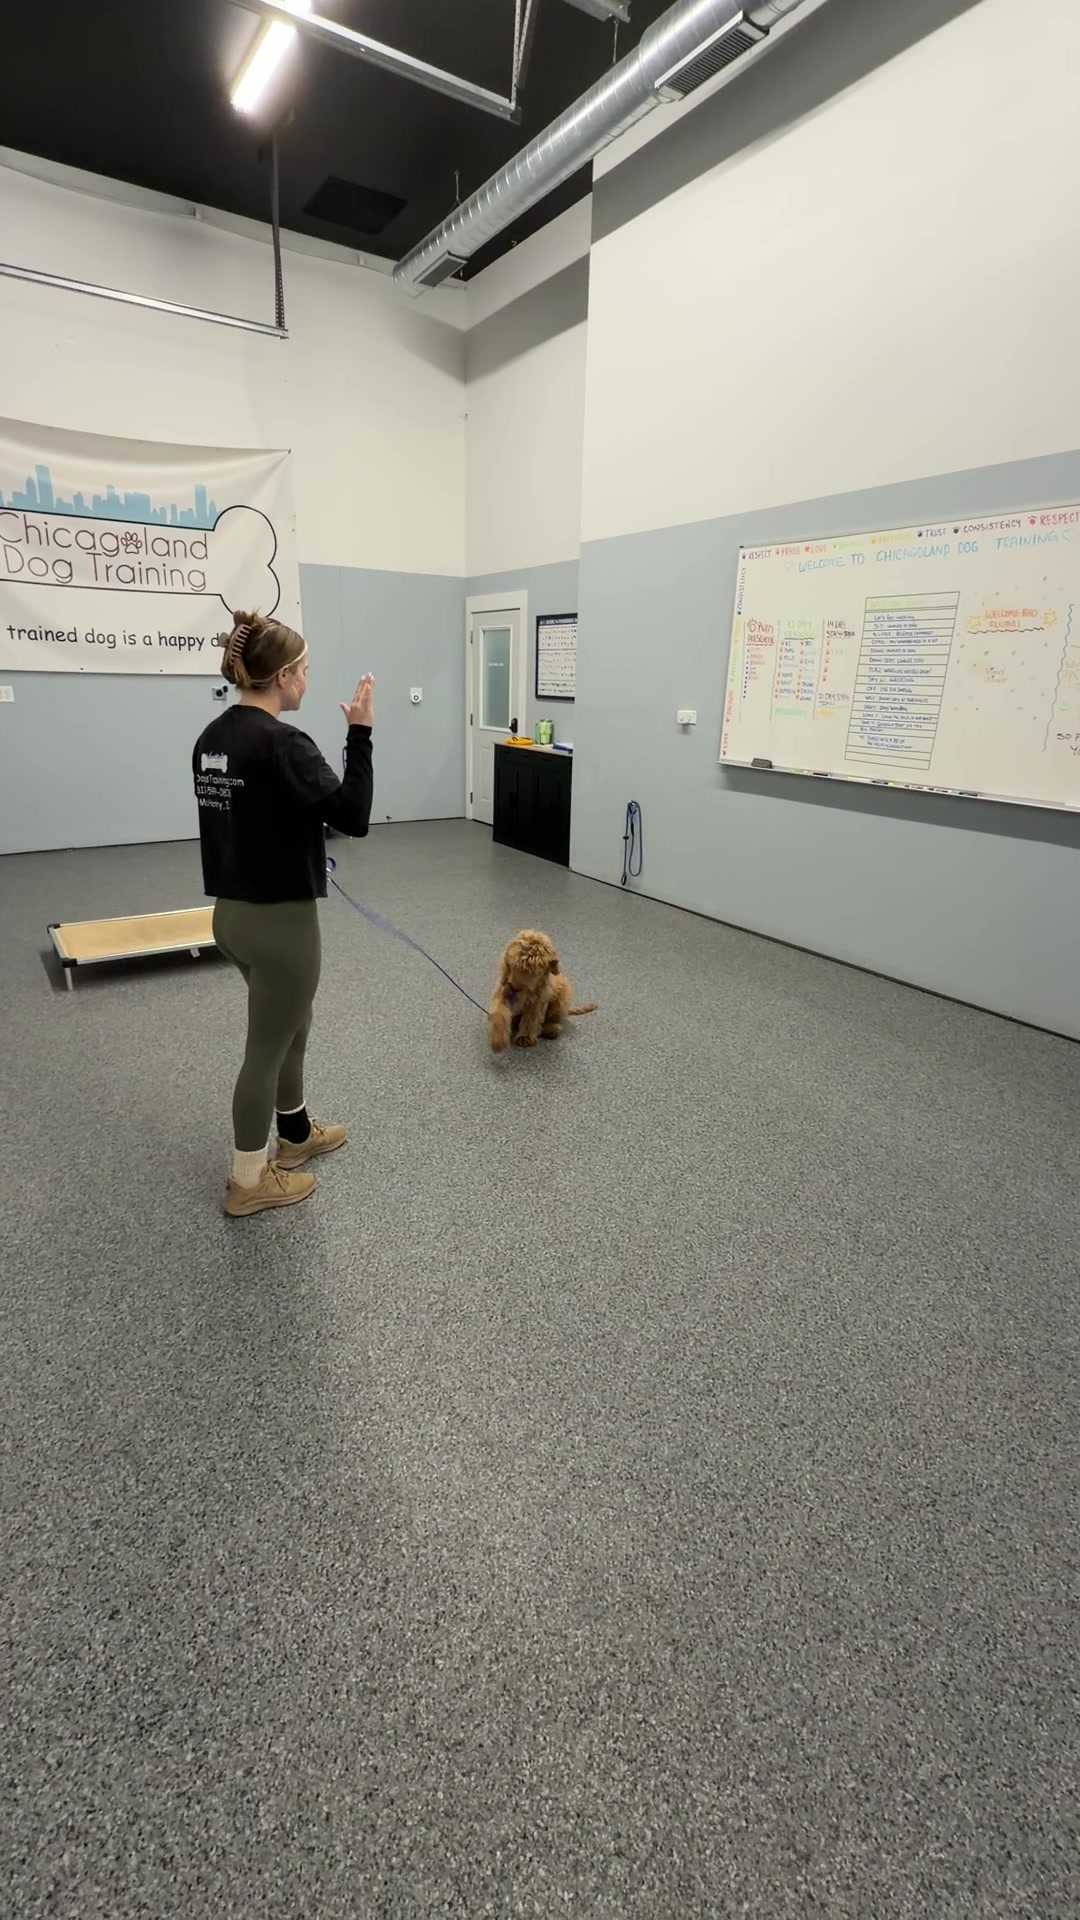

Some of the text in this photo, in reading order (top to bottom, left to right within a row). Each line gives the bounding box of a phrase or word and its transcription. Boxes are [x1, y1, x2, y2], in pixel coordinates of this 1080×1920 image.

[798, 555, 845, 573] WELCOME
[850, 552, 865, 566] TO
[875, 543, 951, 563] CHICAGOLAND
[957, 541, 979, 554] DOG
[996, 530, 1059, 550] TRAINING
[810, 543, 827, 554] LOVE
[925, 527, 947, 538] TRUST
[962, 518, 1022, 533] CONSISTENCY
[4, 544, 207, 592] Dog Training
[6, 624, 78, 643] trained
[84, 626, 117, 648] dog
[122, 631, 137, 646] is
[142, 636, 153, 646] a
[158, 631, 206, 651] happy
[1056, 732, 1071, 740] SO
